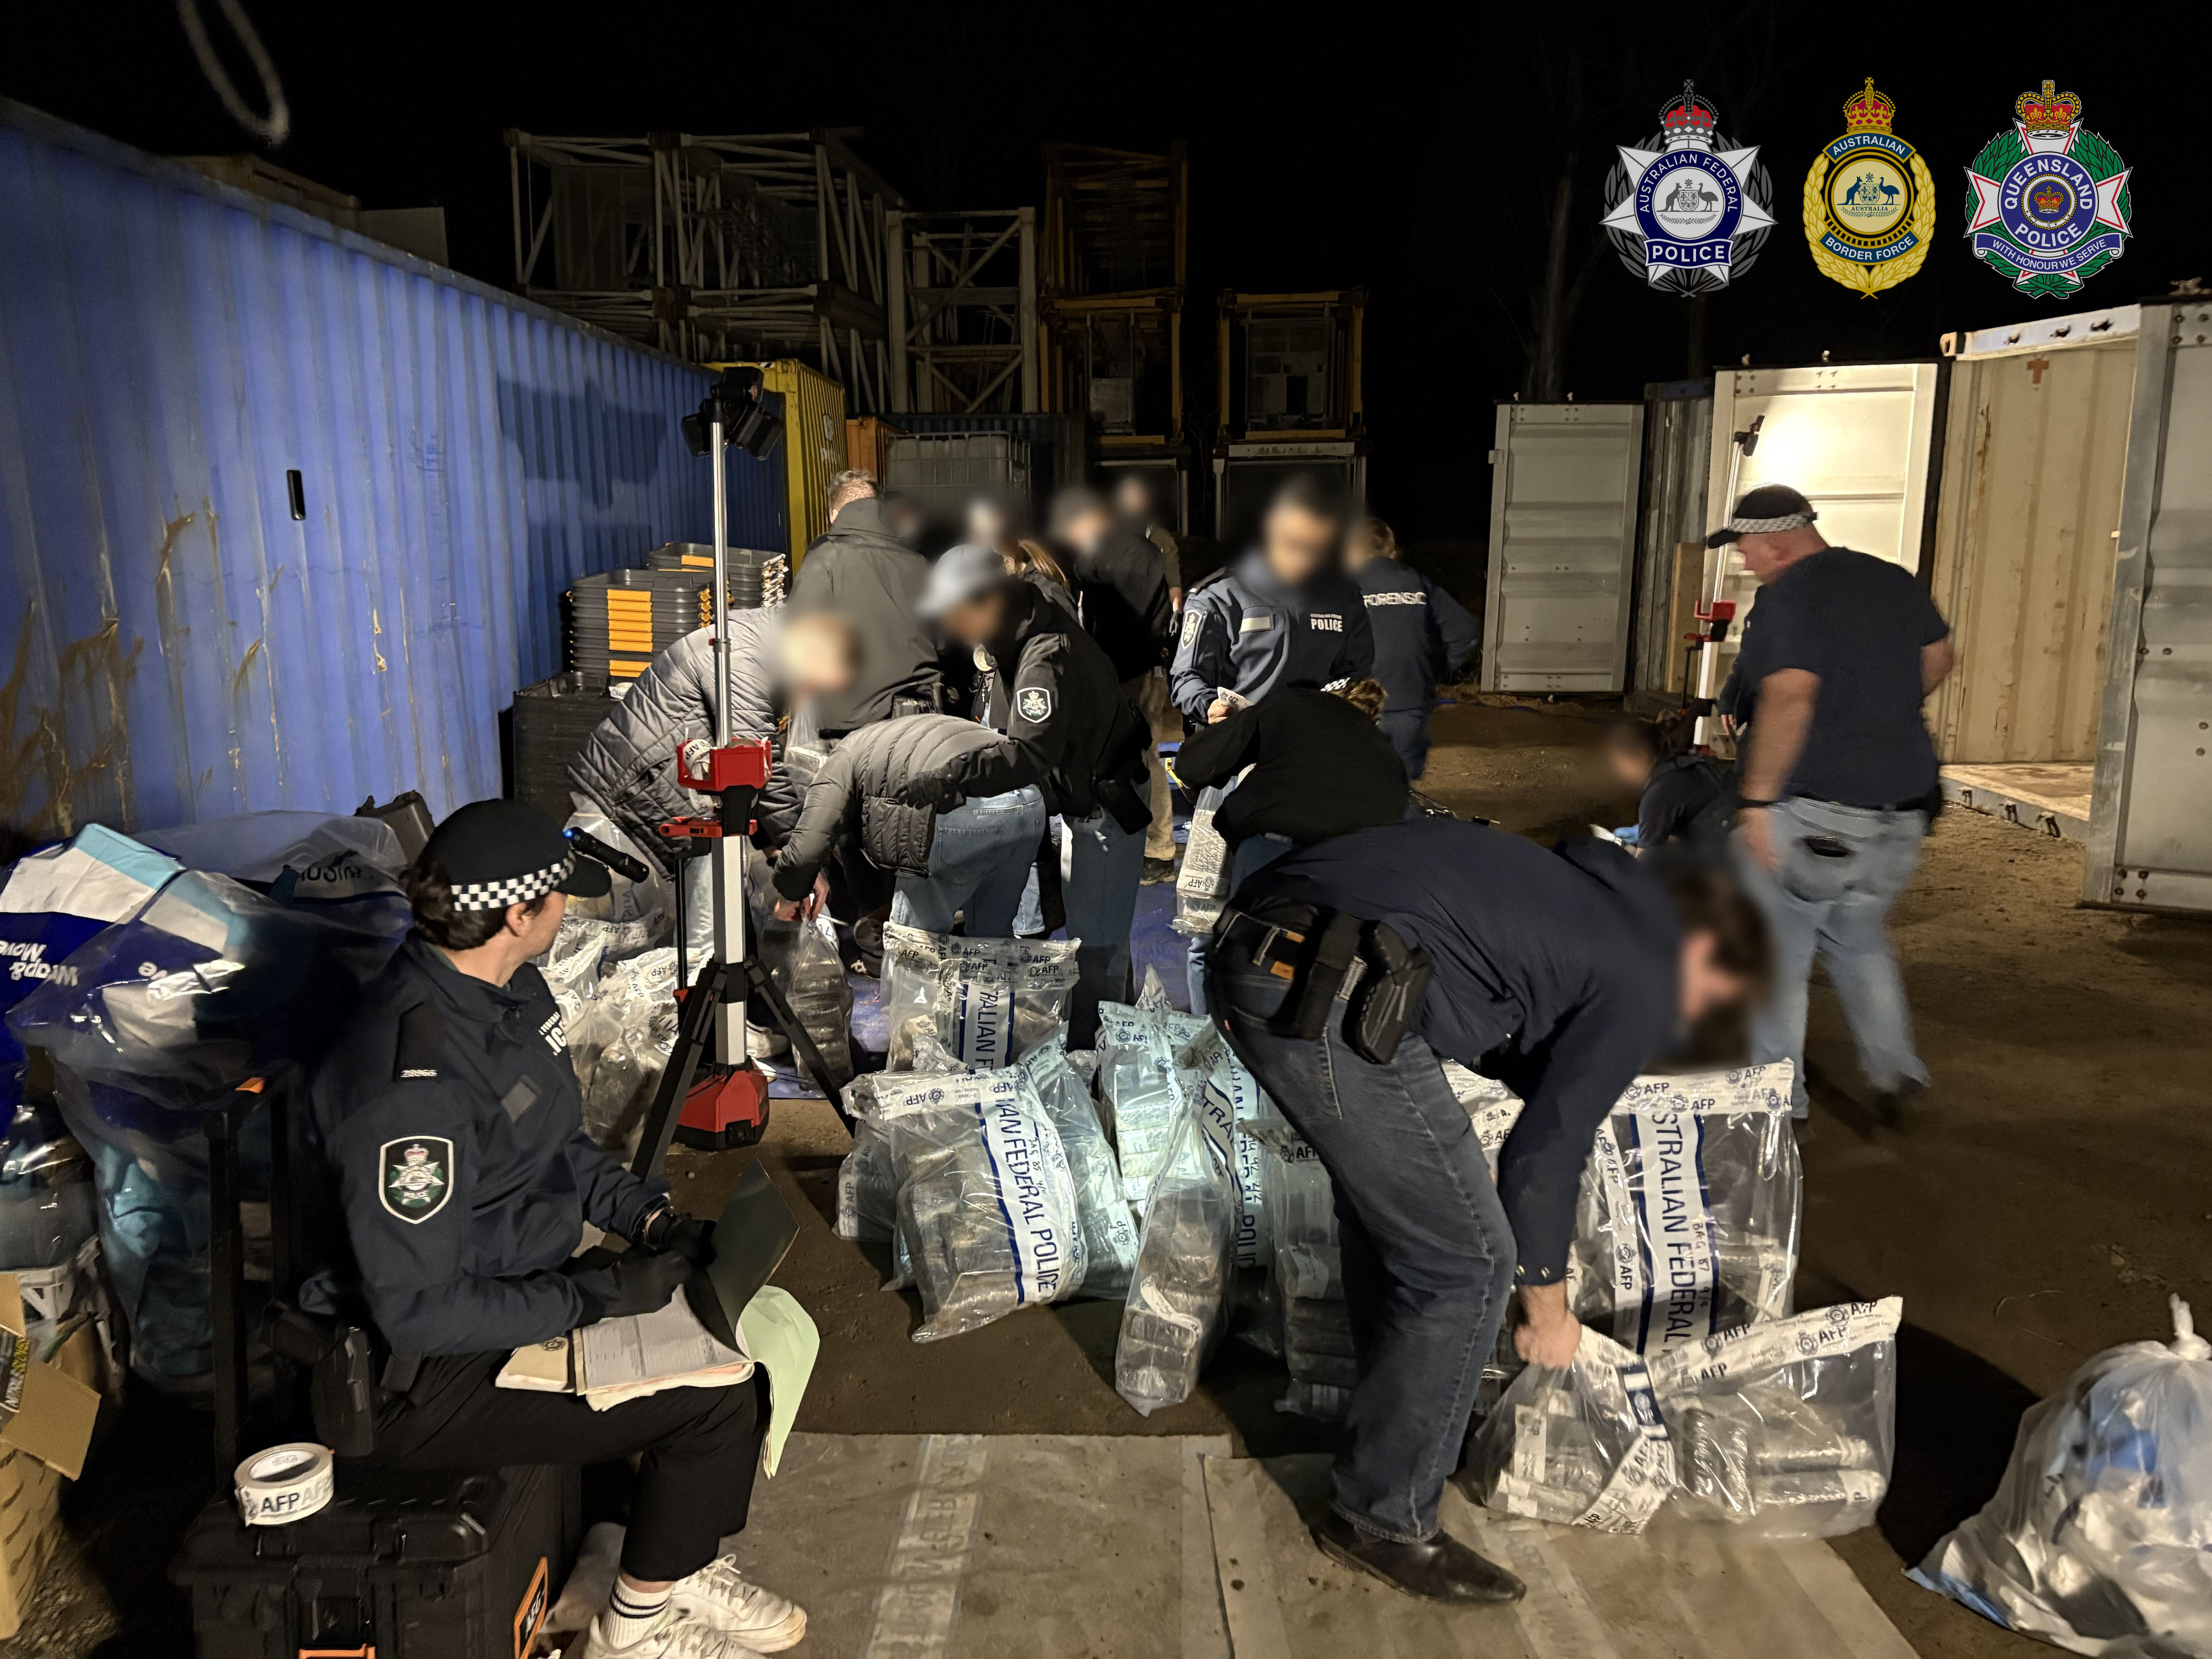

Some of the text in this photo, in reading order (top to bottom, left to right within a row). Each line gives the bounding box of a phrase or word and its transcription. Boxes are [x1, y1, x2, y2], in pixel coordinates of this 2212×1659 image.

[1310, 618, 1343, 632] POLICE
[1188, 878, 1205, 888] AFP
[602, 925, 621, 933] AFP
[900, 949, 919, 959] AFP
[962, 948, 981, 957] AFP
[1032, 955, 1051, 964] AFP
[970, 962, 988, 971] AFP
[1042, 965, 1059, 974] AFP
[976, 991, 999, 1053] RALIAN
[1744, 1066, 1766, 1079] AFP
[1643, 1082, 1670, 1094] AFP
[905, 1092, 927, 1106] AFP
[1691, 1098, 1716, 1111] AFP
[1494, 1128, 1510, 1141] AF
[846, 1182, 854, 1202] AFP
[1003, 1138, 1045, 1225] FEDERAL
[1030, 1228, 1060, 1293] POLICE
[1651, 1114, 1697, 1343] STRALIAN FEDERAL
[1693, 1222, 1706, 1249] BAG
[1698, 1258, 1710, 1272] 87
[1619, 1265, 1633, 1291] AFP
[1850, 1301, 1878, 1317] AFP
[1723, 1324, 1751, 1342] AFP
[1818, 1325, 1847, 1343] AFP
[1701, 1362, 1728, 1379] AFP
[260, 1492, 300, 1512] AFP
